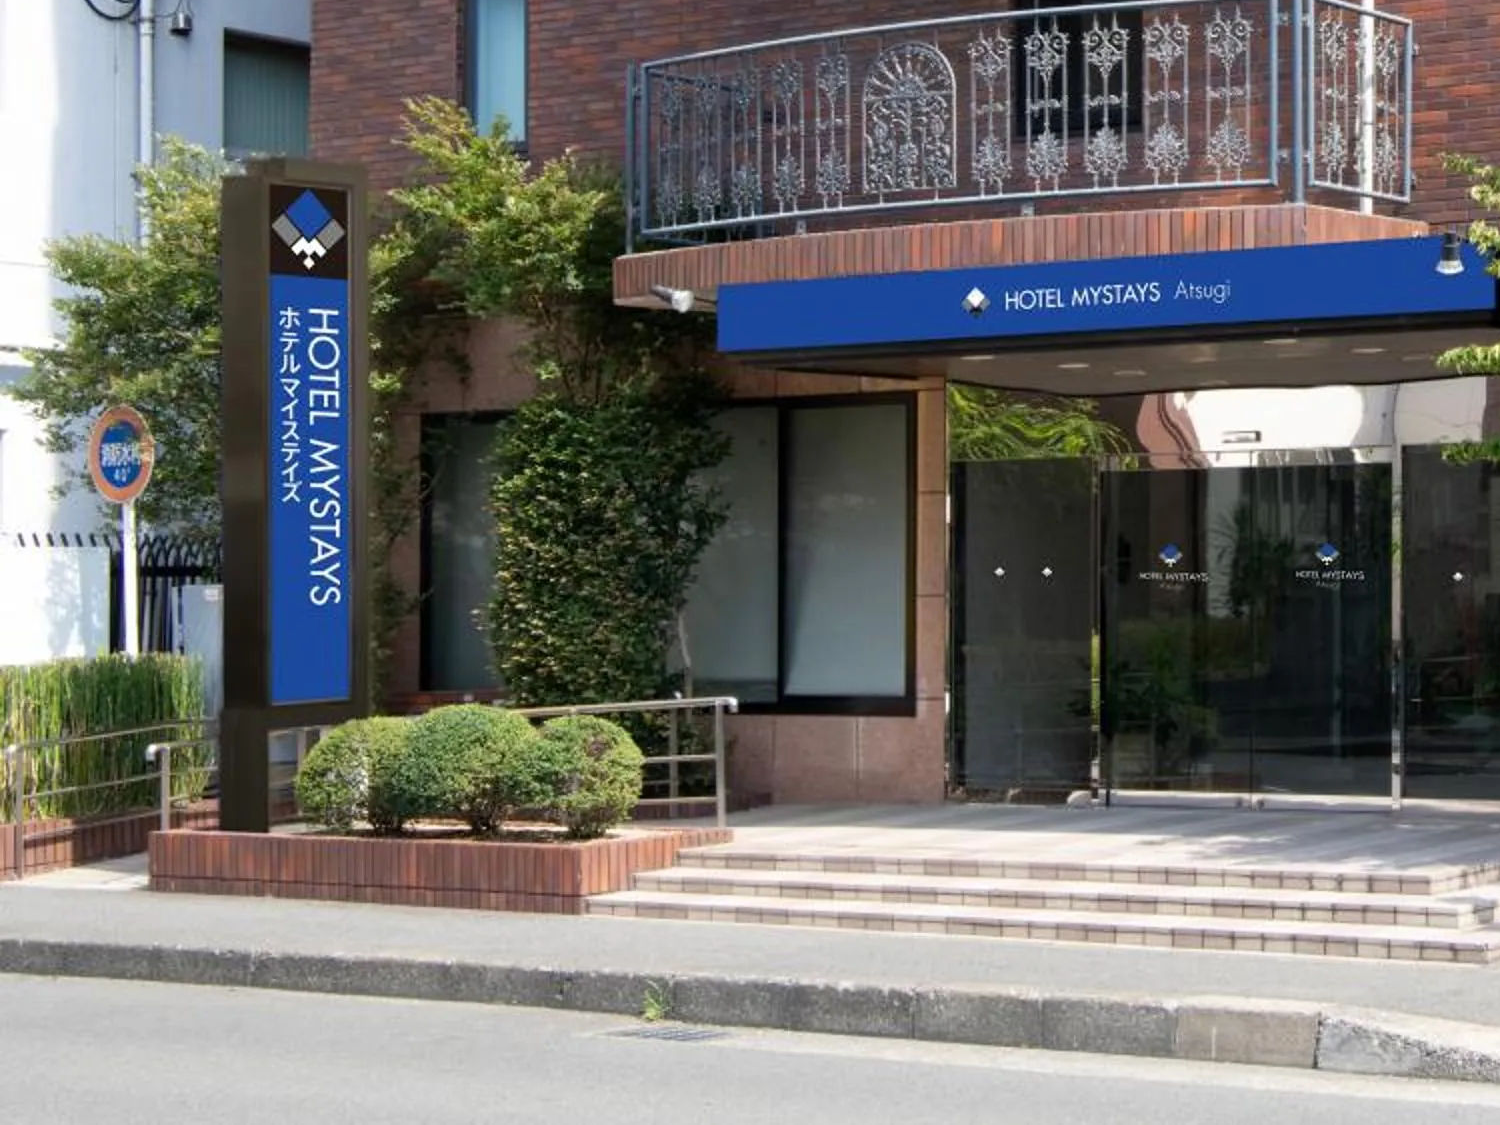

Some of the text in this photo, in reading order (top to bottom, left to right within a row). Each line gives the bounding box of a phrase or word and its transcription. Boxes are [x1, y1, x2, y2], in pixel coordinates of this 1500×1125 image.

[1005, 279, 1231, 311] HOTEL MYSTAYS Atsugi
[279, 306, 303, 503] ホテルマイステイズ
[308, 308, 341, 606] HOTEL MYSTAYS
